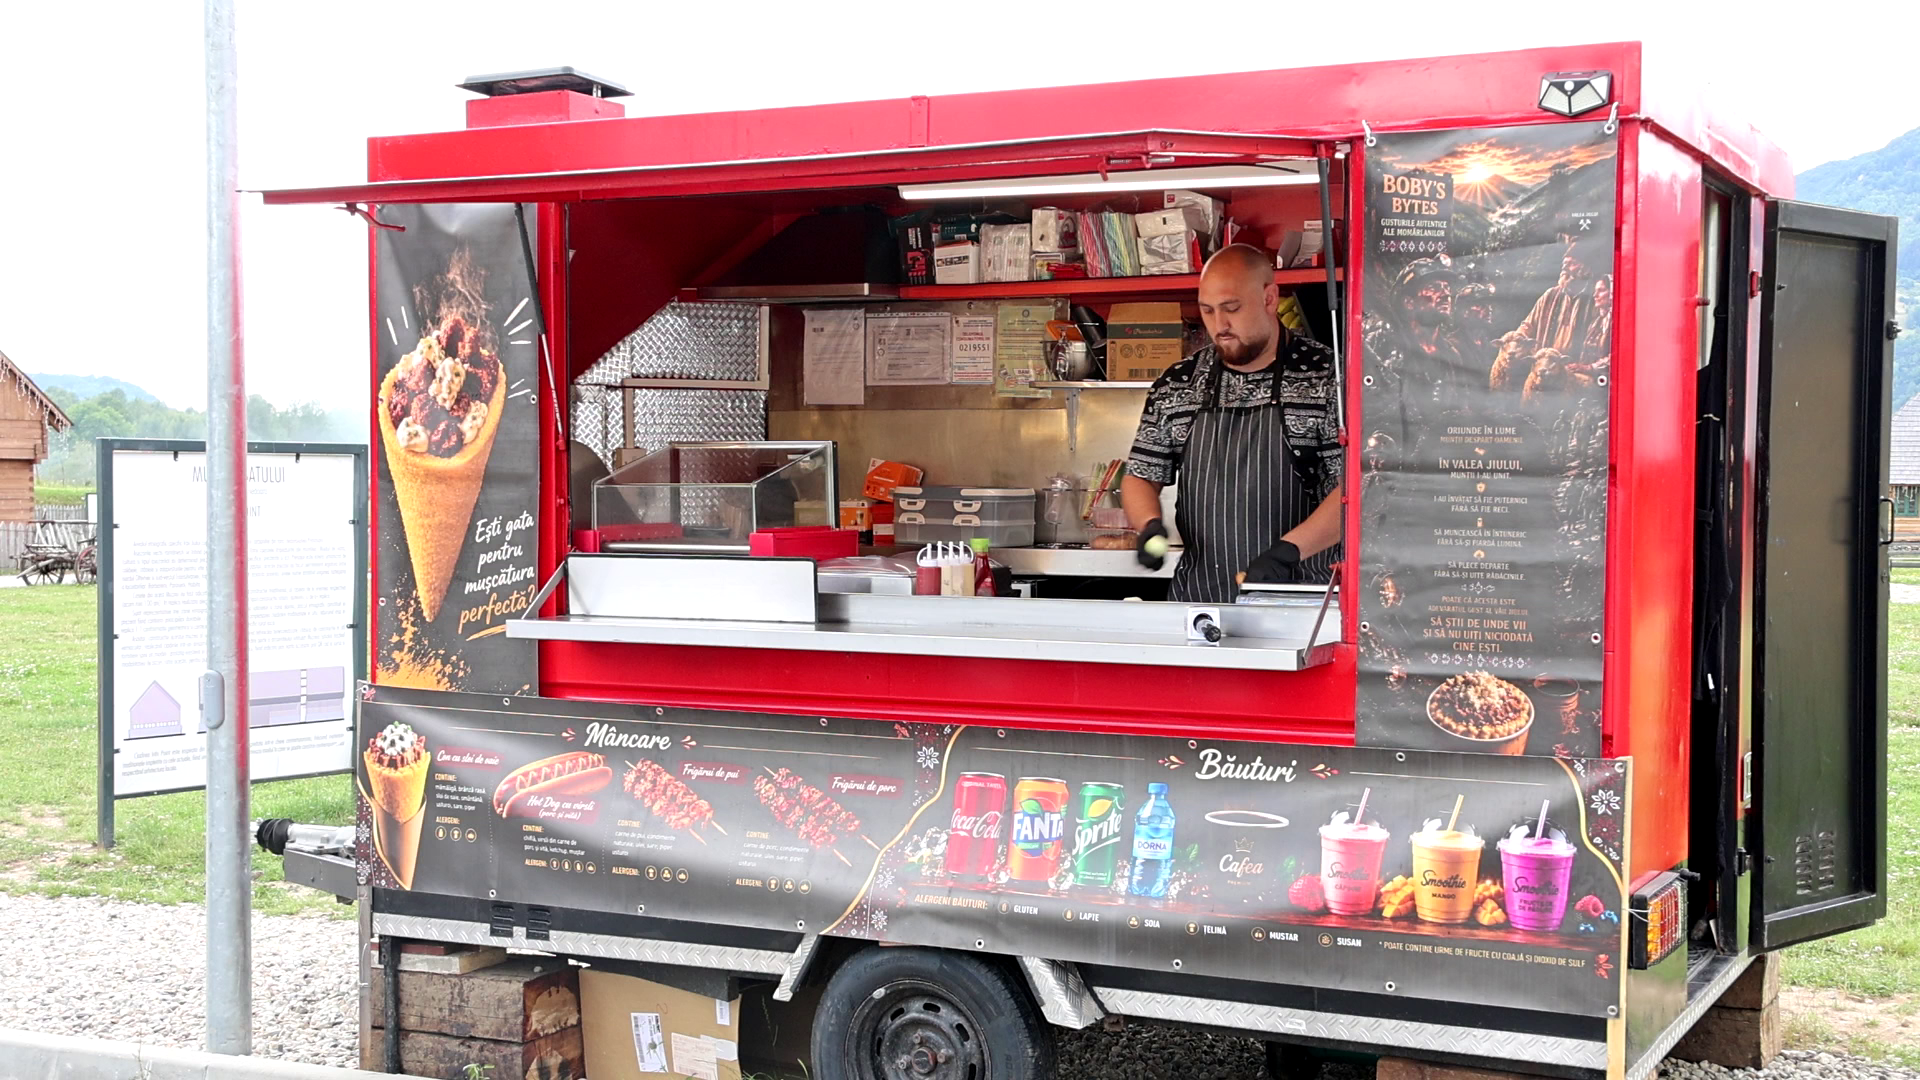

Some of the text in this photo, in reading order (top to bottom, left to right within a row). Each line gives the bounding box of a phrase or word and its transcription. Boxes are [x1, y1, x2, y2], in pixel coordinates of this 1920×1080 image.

[1383, 174, 1446, 199] BOBY'S
[1392, 197, 1438, 215] BYTES
[1380, 218, 1447, 229] GUSTURILE AUTENTICE
[1383, 228, 1395, 236] ALE
[959, 344, 990, 352] 0219551
[1447, 425, 1516, 435] ORIUNDE ÎN LUME
[1439, 457, 1523, 471] ÎN VALEA JIULUI,
[246, 466, 285, 483] ATULUI
[1483, 496, 1493, 504] FIE
[246, 506, 260, 517] INT
[475, 510, 535, 543] Ești gata
[477, 542, 523, 574] pentru
[464, 564, 535, 594] mușcătura
[1430, 616, 1527, 630] SĂ ȘTII DE UNDE VII
[1434, 628, 1446, 638] SĂ
[1448, 630, 1461, 639] NU
[1485, 632, 1533, 642] NICIODATĂ
[1453, 641, 1476, 652] CINE
[584, 721, 671, 750] Mâncare
[437, 750, 452, 762] Con
[475, 754, 484, 764] de
[682, 763, 740, 780] Frigărui de pui
[1195, 748, 1297, 782] Băuturi
[832, 777, 898, 795] Frigărui de porc
[527, 795, 544, 806] Hot
[543, 796, 561, 812] Dog
[1012, 812, 1064, 841] FANTA
[1072, 808, 1122, 855] Sprite
[1138, 841, 1167, 850] DORNA
[1219, 854, 1264, 878] Cafea
[1420, 869, 1467, 889] Smoothie
[914, 893, 989, 910] ALERGENI BĂUTURI:
[1431, 892, 1457, 900] MANGO
[1013, 904, 1039, 915] GLUTEN
[1079, 912, 1100, 922] LAPTE
[1144, 919, 1161, 929] SOIA
[1337, 937, 1362, 947] SUSAN
[1384, 941, 1404, 951] POATE
[1434, 945, 1453, 955] URME
[1455, 948, 1464, 956] DE
[1465, 949, 1490, 959] FRUCTE
[1491, 951, 1501, 960] CU
[1502, 952, 1525, 962] COAJĂ
[1534, 955, 1556, 965] DIOXID
[1558, 957, 1567, 966] DE
[1568, 958, 1586, 968] SULF
